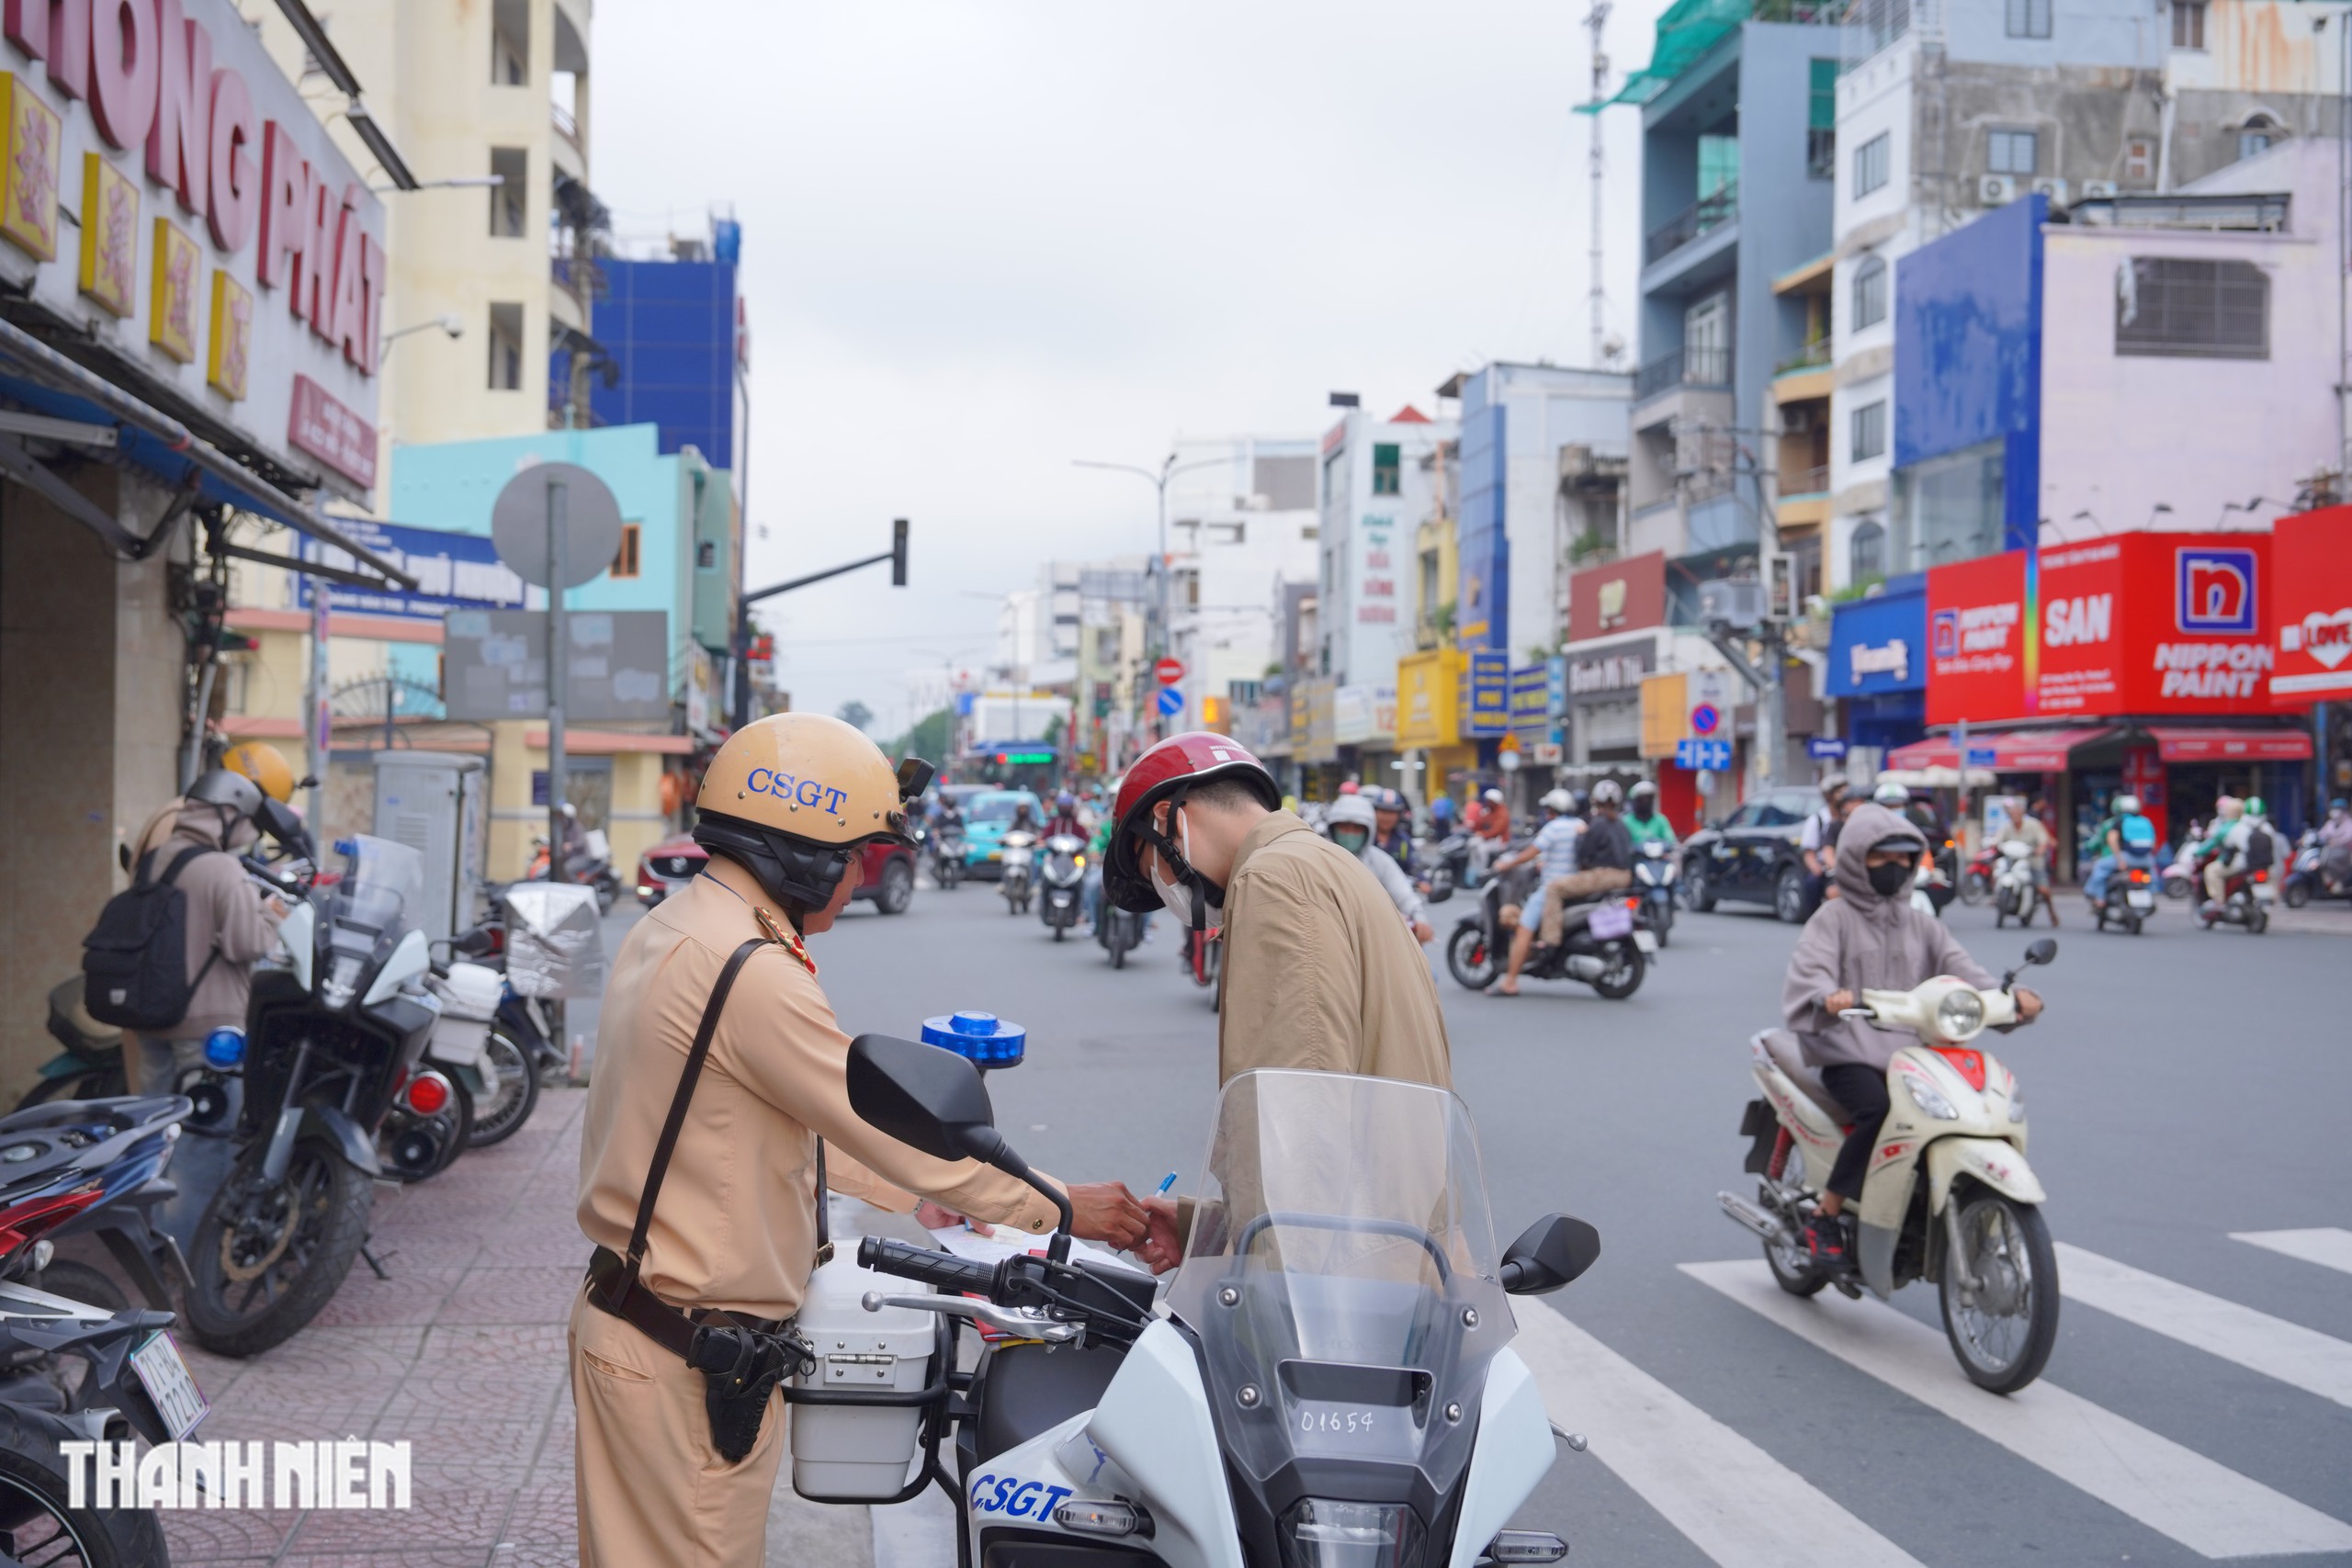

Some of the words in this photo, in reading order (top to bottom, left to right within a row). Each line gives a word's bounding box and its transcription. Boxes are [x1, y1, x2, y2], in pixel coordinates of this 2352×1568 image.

[257, 118, 387, 378] PHÁT
[2044, 593, 2112, 649] SAN
[2154, 643, 2274, 671] NIPPON
[2161, 671, 2260, 698] PAINT
[747, 767, 848, 816] CSGT
[1301, 1410, 1374, 1434] 01654
